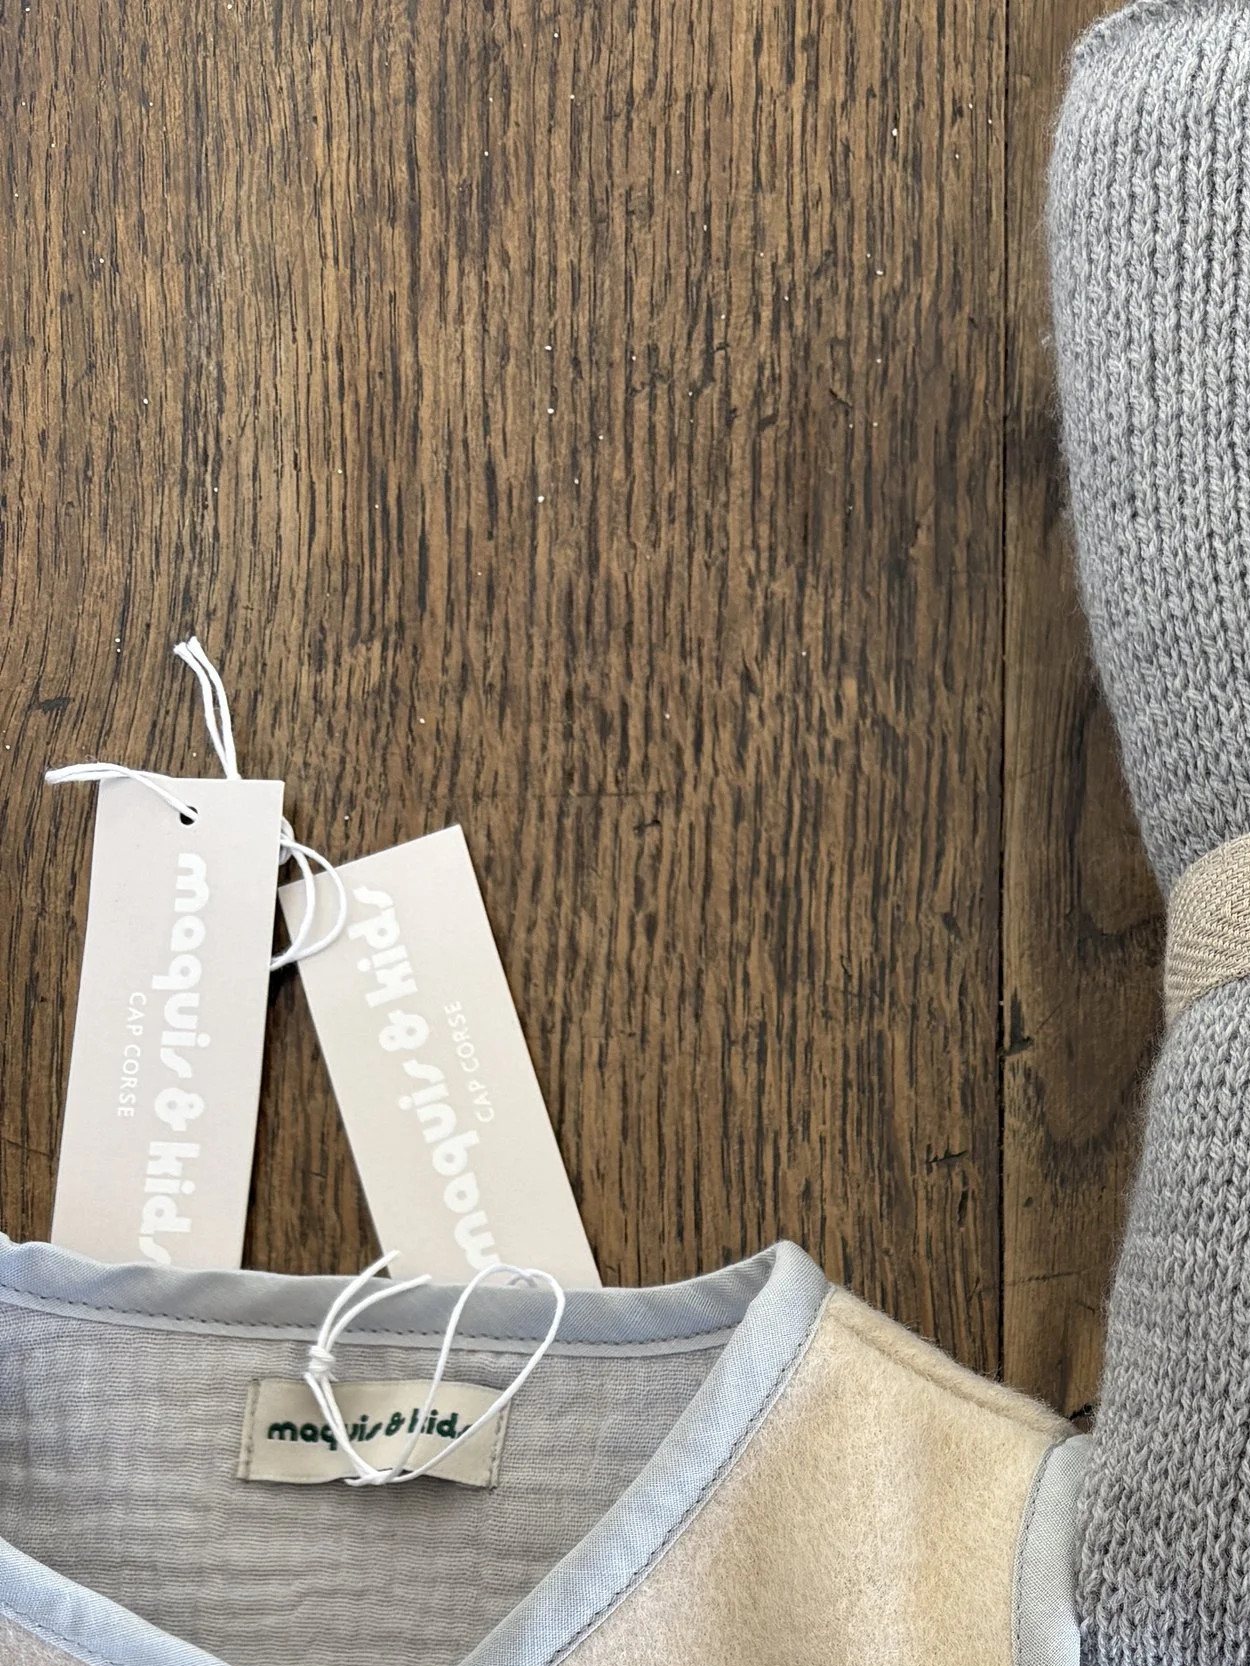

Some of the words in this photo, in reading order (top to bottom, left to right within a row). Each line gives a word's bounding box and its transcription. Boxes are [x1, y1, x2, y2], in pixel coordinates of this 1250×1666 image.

[152, 853, 211, 1078] maquis
[347, 885, 418, 1008] kids
[127, 992, 147, 1036] CAP
[378, 1009, 430, 1052] &
[444, 1001, 479, 1072] CORSE
[117, 1044, 141, 1117] CORSE
[154, 1087, 205, 1131] &
[468, 1080, 495, 1122] CAP
[397, 1059, 501, 1270] maquis
[138, 1141, 200, 1265] kids
[385, 1412, 405, 1436] &
